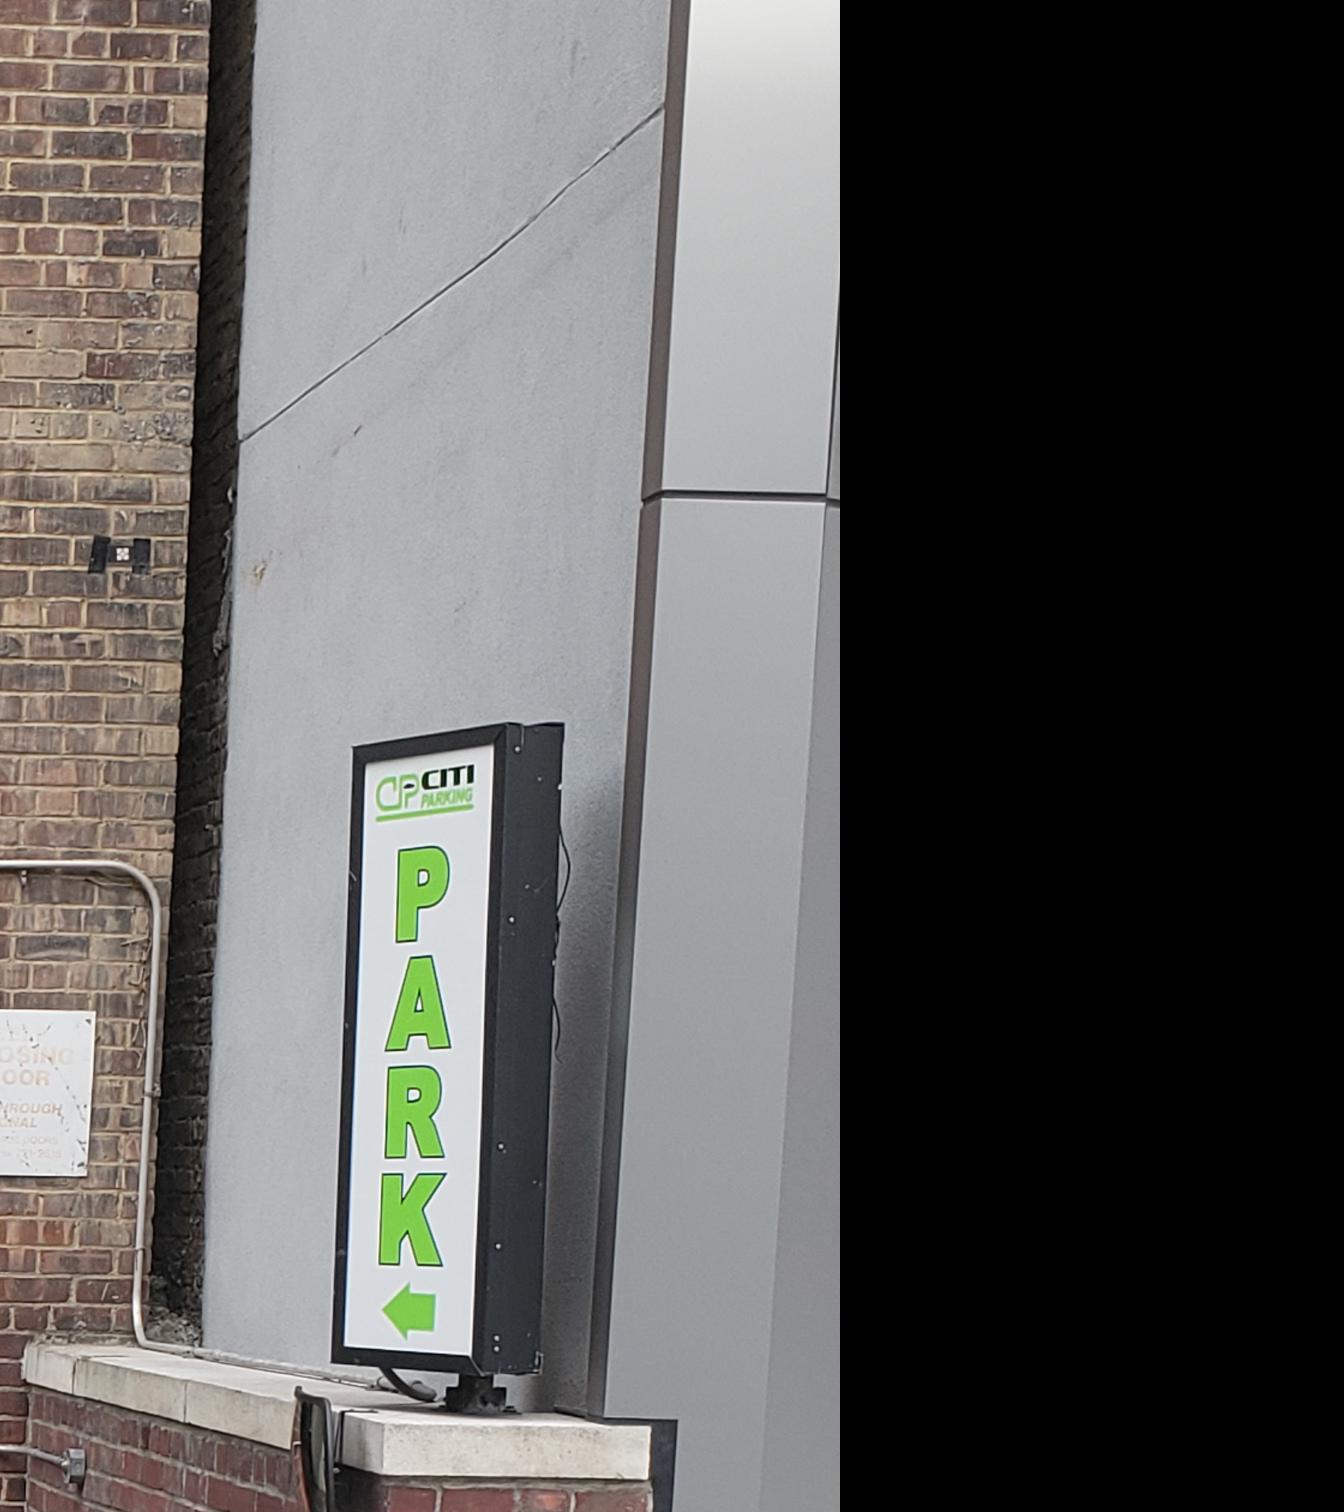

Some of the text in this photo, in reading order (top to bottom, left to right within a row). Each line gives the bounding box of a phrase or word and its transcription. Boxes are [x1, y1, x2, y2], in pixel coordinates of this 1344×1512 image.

[422, 764, 475, 790] CITI
[420, 788, 473, 808] PARKING
[378, 846, 451, 1266] PARK
